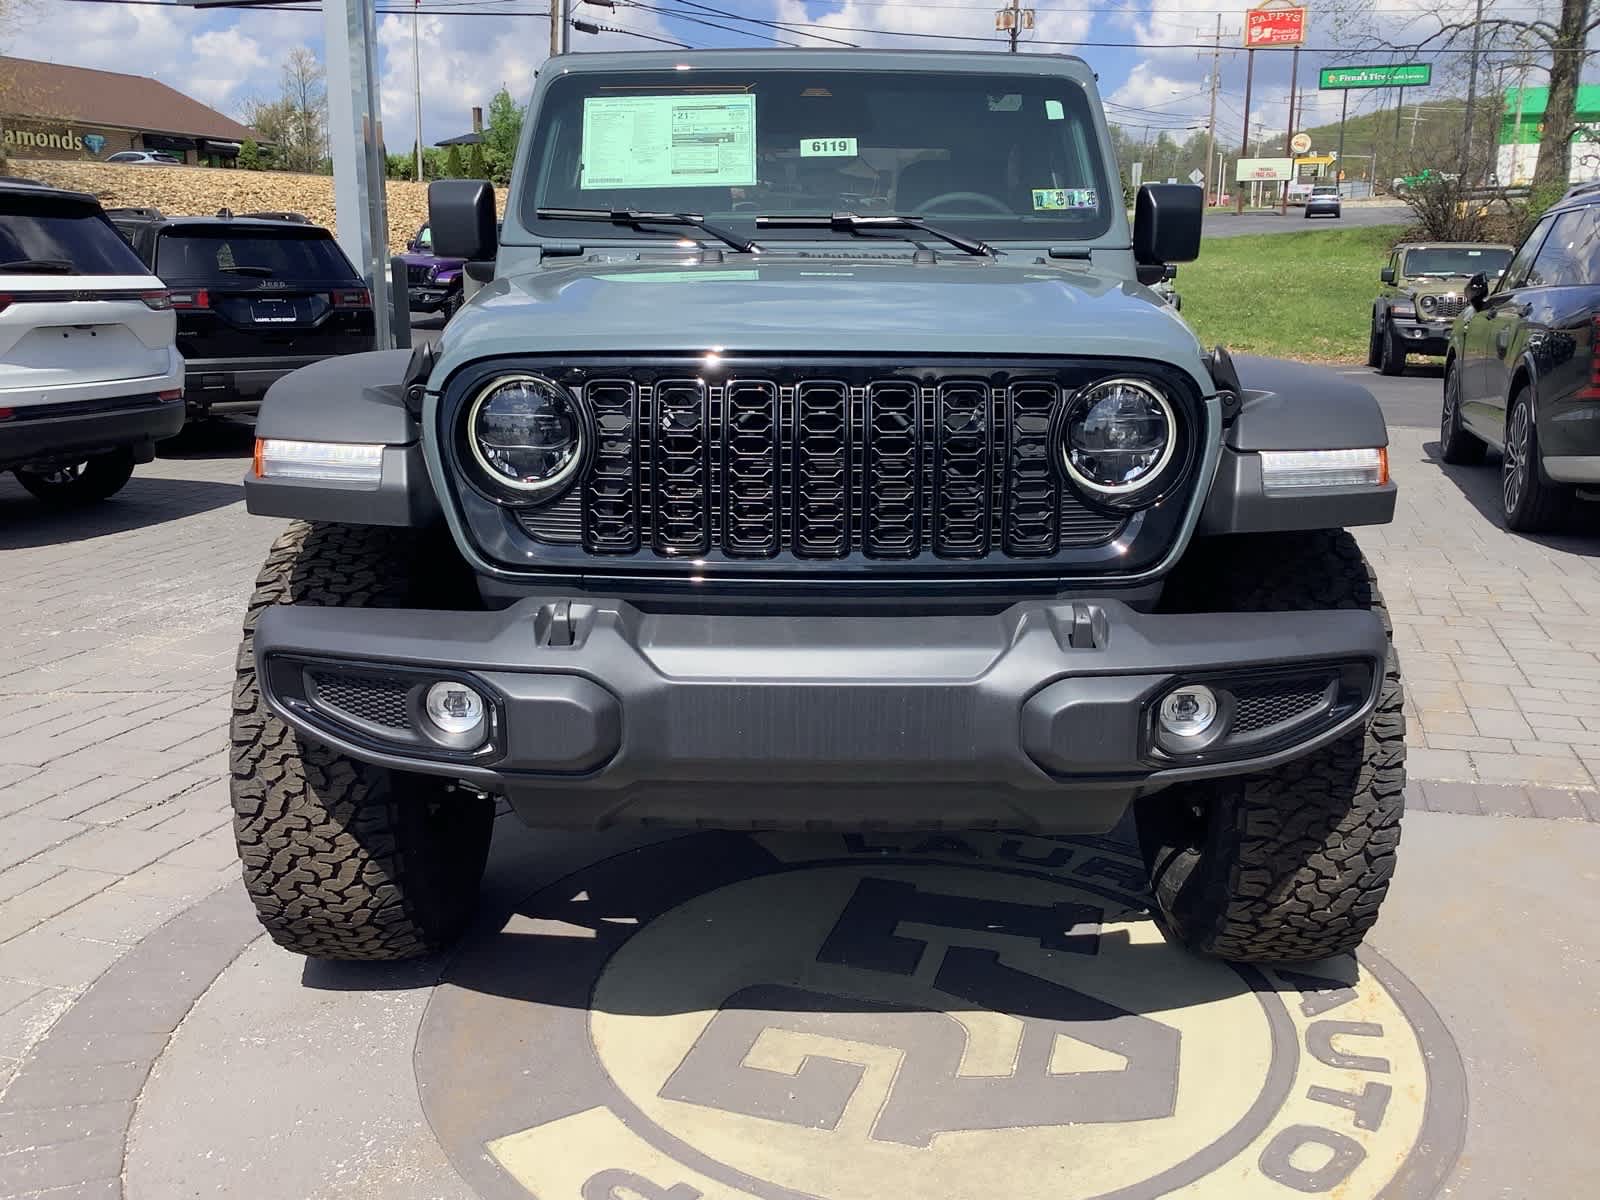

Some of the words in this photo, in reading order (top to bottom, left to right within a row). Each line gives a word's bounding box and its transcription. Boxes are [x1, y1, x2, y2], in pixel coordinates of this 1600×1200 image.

[4, 129, 82, 151] amonds
[812, 140, 848, 152] 6119
[1258, 968, 1393, 1194] AUTO
